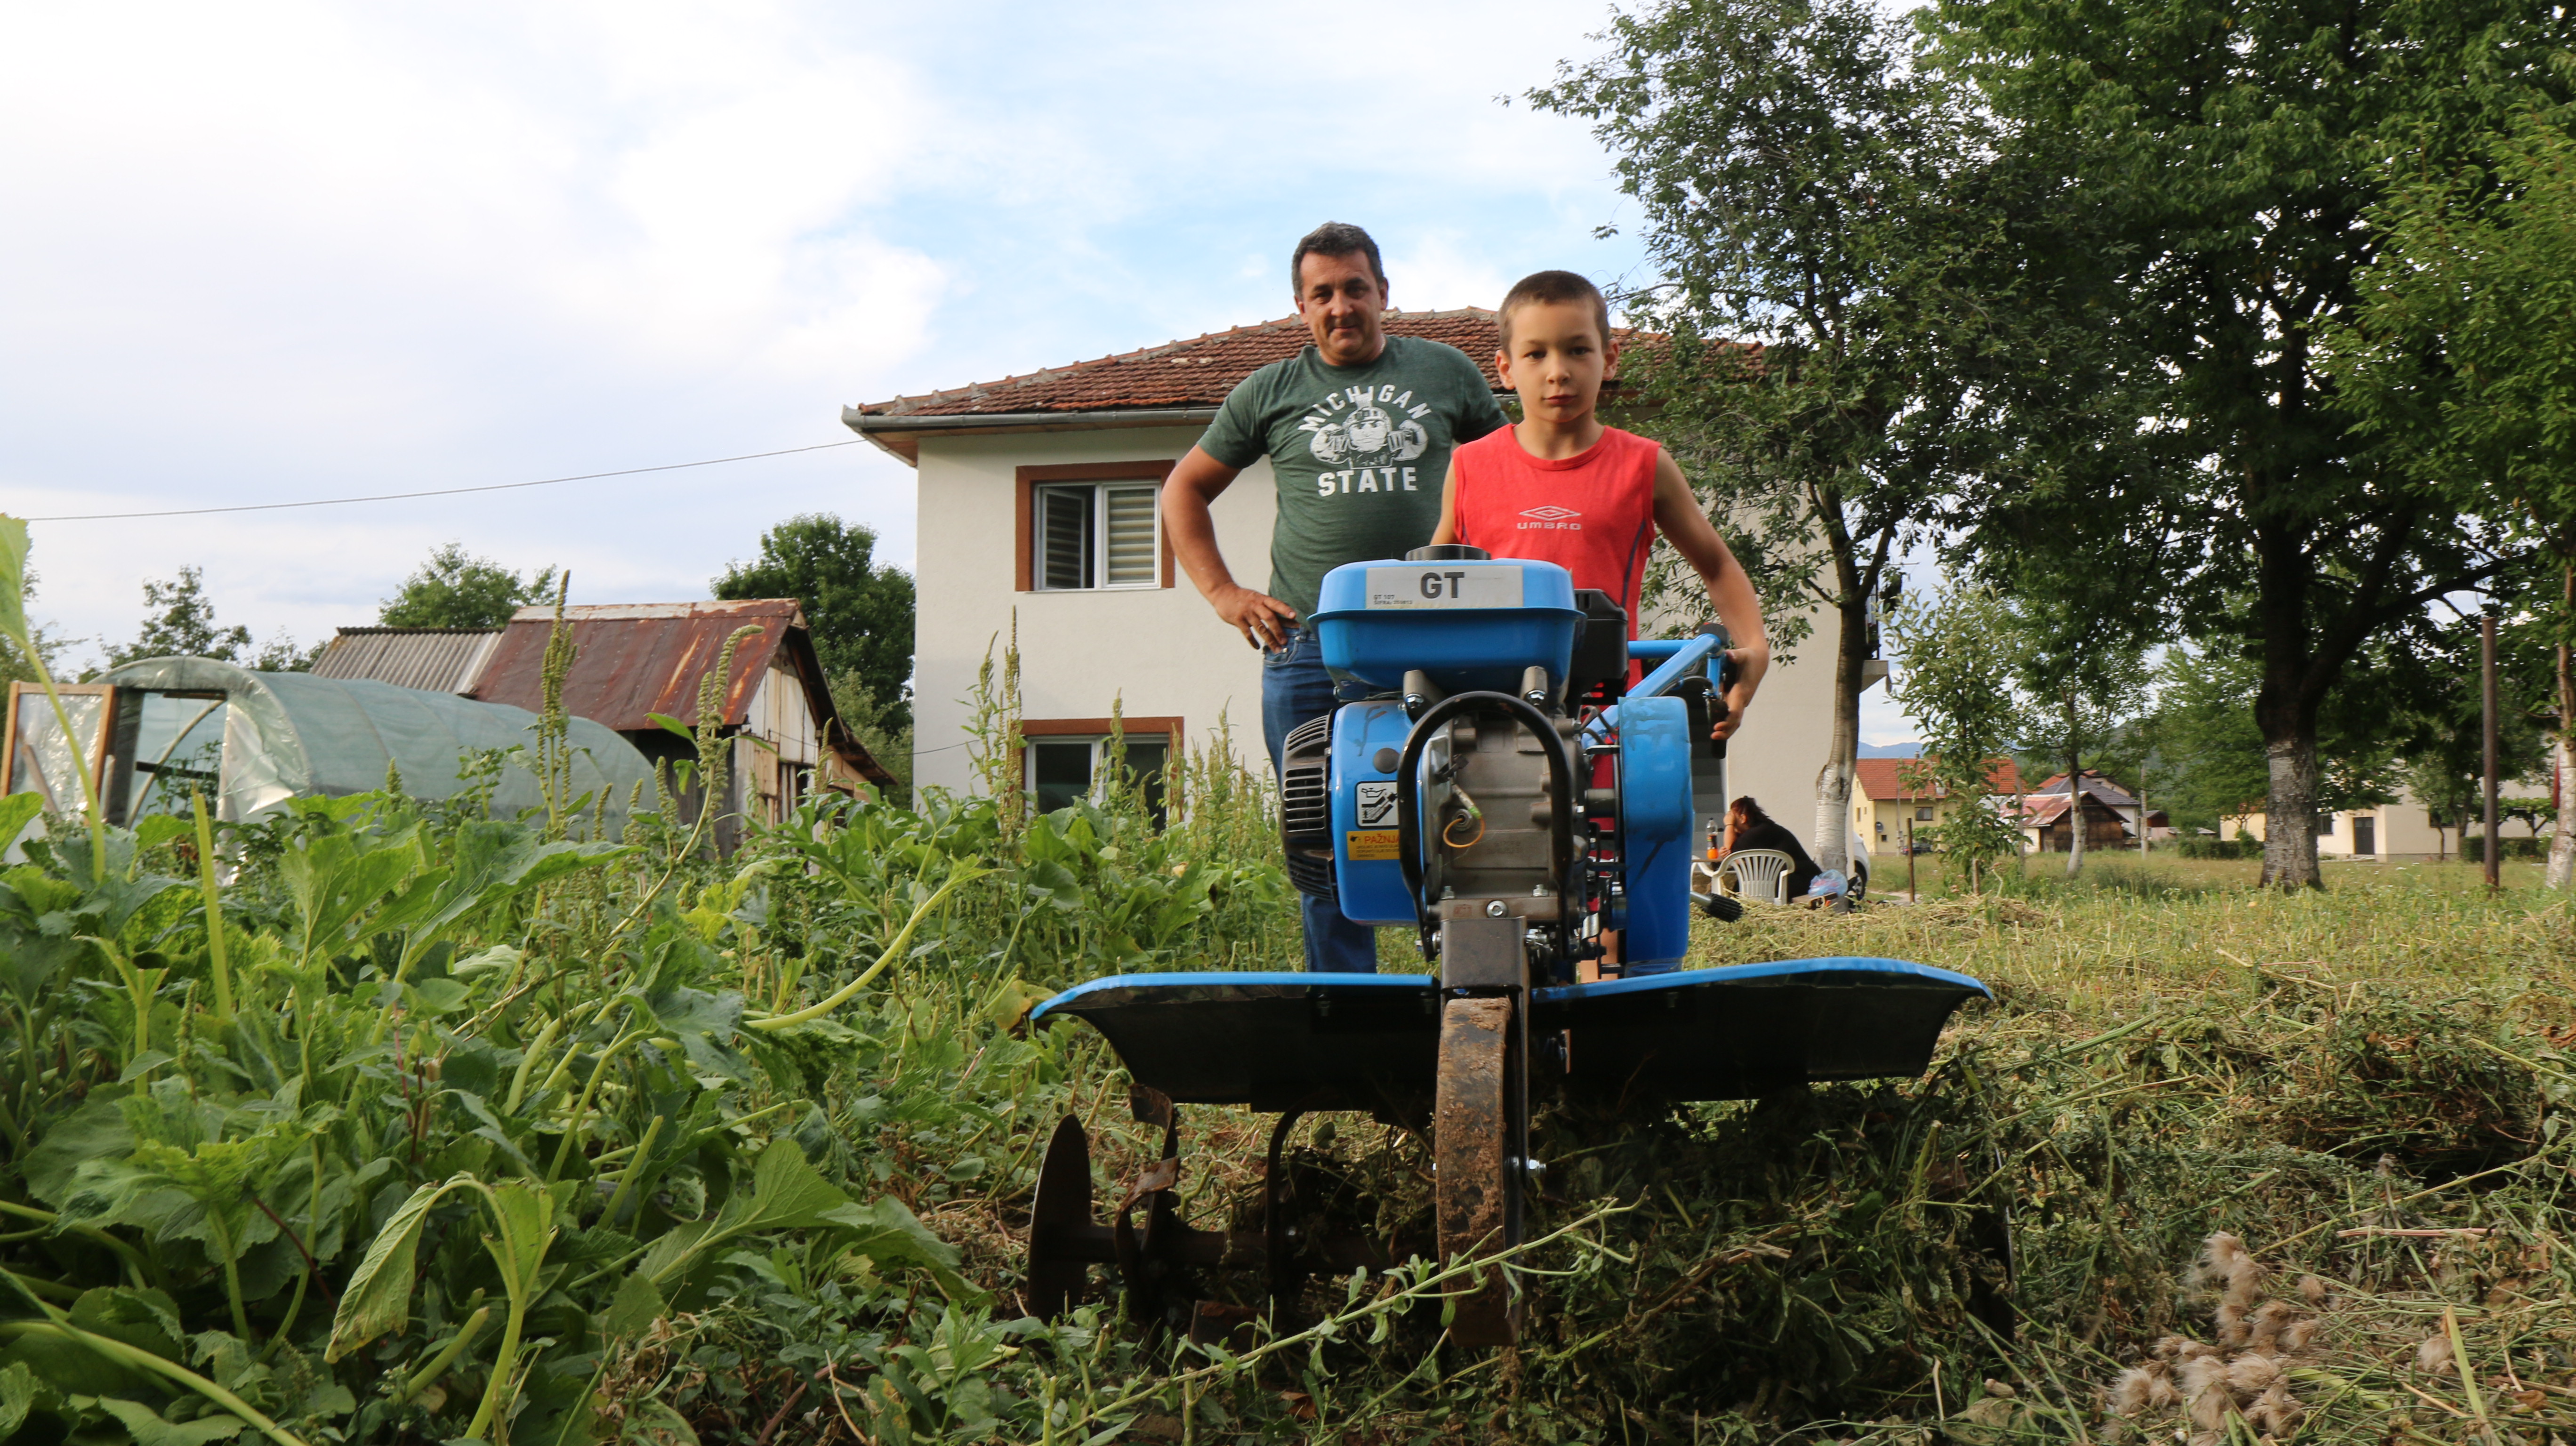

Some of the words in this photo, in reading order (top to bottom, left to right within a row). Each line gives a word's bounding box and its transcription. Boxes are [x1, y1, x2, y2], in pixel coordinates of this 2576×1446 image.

[1297, 384, 1432, 432] MICHIGAN
[1318, 467, 1418, 497] STATE
[1517, 522, 1581, 530] UMBRO
[1421, 572, 1465, 599] GT
